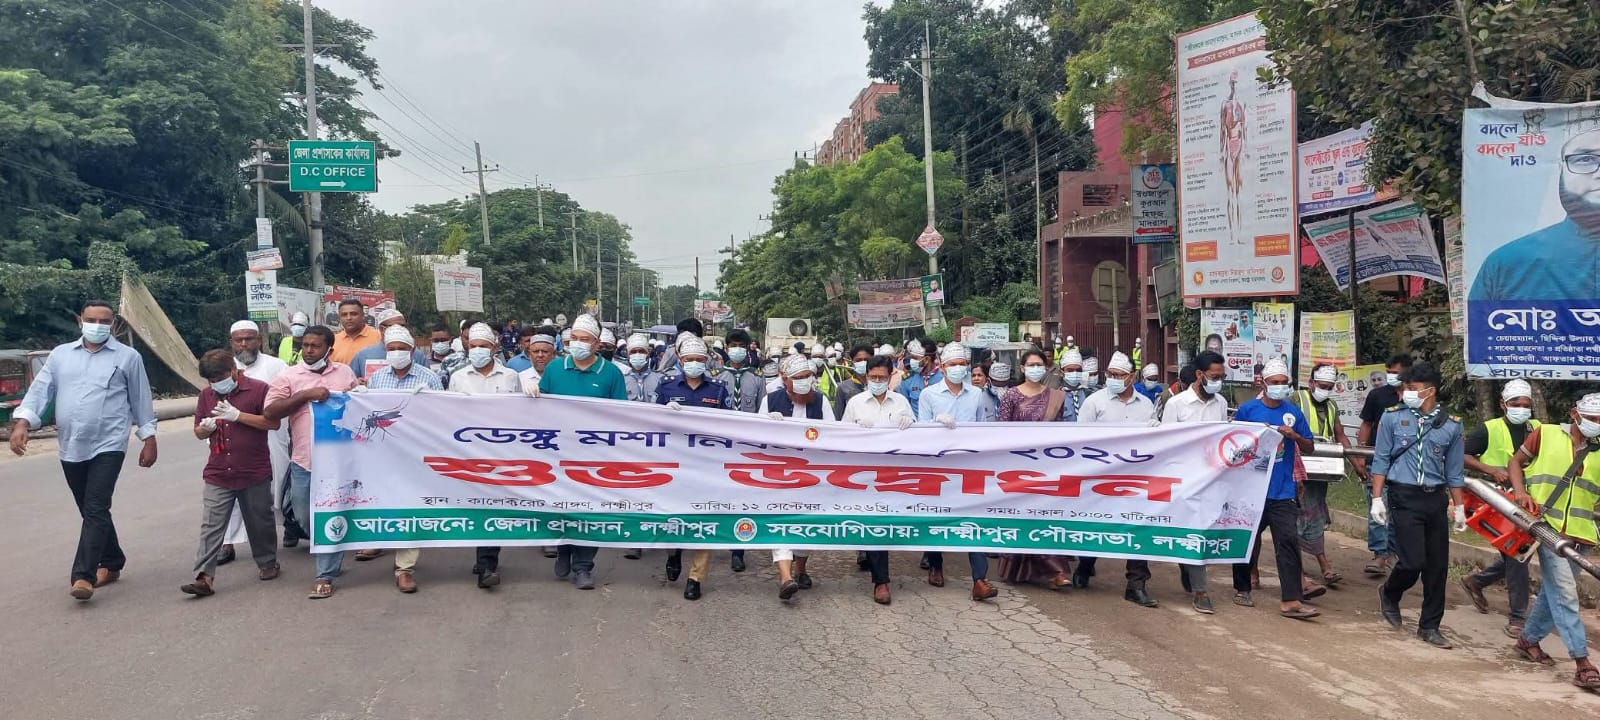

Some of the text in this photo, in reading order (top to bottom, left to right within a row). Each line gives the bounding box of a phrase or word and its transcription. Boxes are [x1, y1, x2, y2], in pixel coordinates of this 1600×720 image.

[1480, 123, 1546, 146] বদলে যাও
[294, 145, 370, 160] জেলা প্রশাসকের কার্যালয়
[1477, 143, 1536, 166] বদলে দাও
[300, 167, 366, 177] D.C OFFICE
[1487, 307, 1557, 331] মোঃ
[453, 426, 560, 450] ডেঙ্গু
[576, 429, 670, 447] মশা
[423, 452, 1182, 502] শুভ উদ্বোধন
[420, 496, 449, 506] স্থান
[467, 497, 545, 508] কালেক্টরেট
[600, 499, 654, 512] লক্ষ্মীপুর
[742, 502, 760, 512] ১২
[905, 503, 952, 514] শনিবার
[1027, 507, 1064, 517] সকাল
[1070, 510, 1113, 519] ১০:০০
[1120, 511, 1172, 523] ঘটিকায়
[484, 516, 538, 533] জেলা
[547, 517, 631, 538] প্রশাসন,
[639, 517, 718, 538] লক্ষ্মীপুর
[928, 520, 1020, 543] লক্ষ্মীপুর
[1028, 524, 1141, 548] পৌরসভা,
[1152, 532, 1232, 555] লক্ষ্মীপুর
